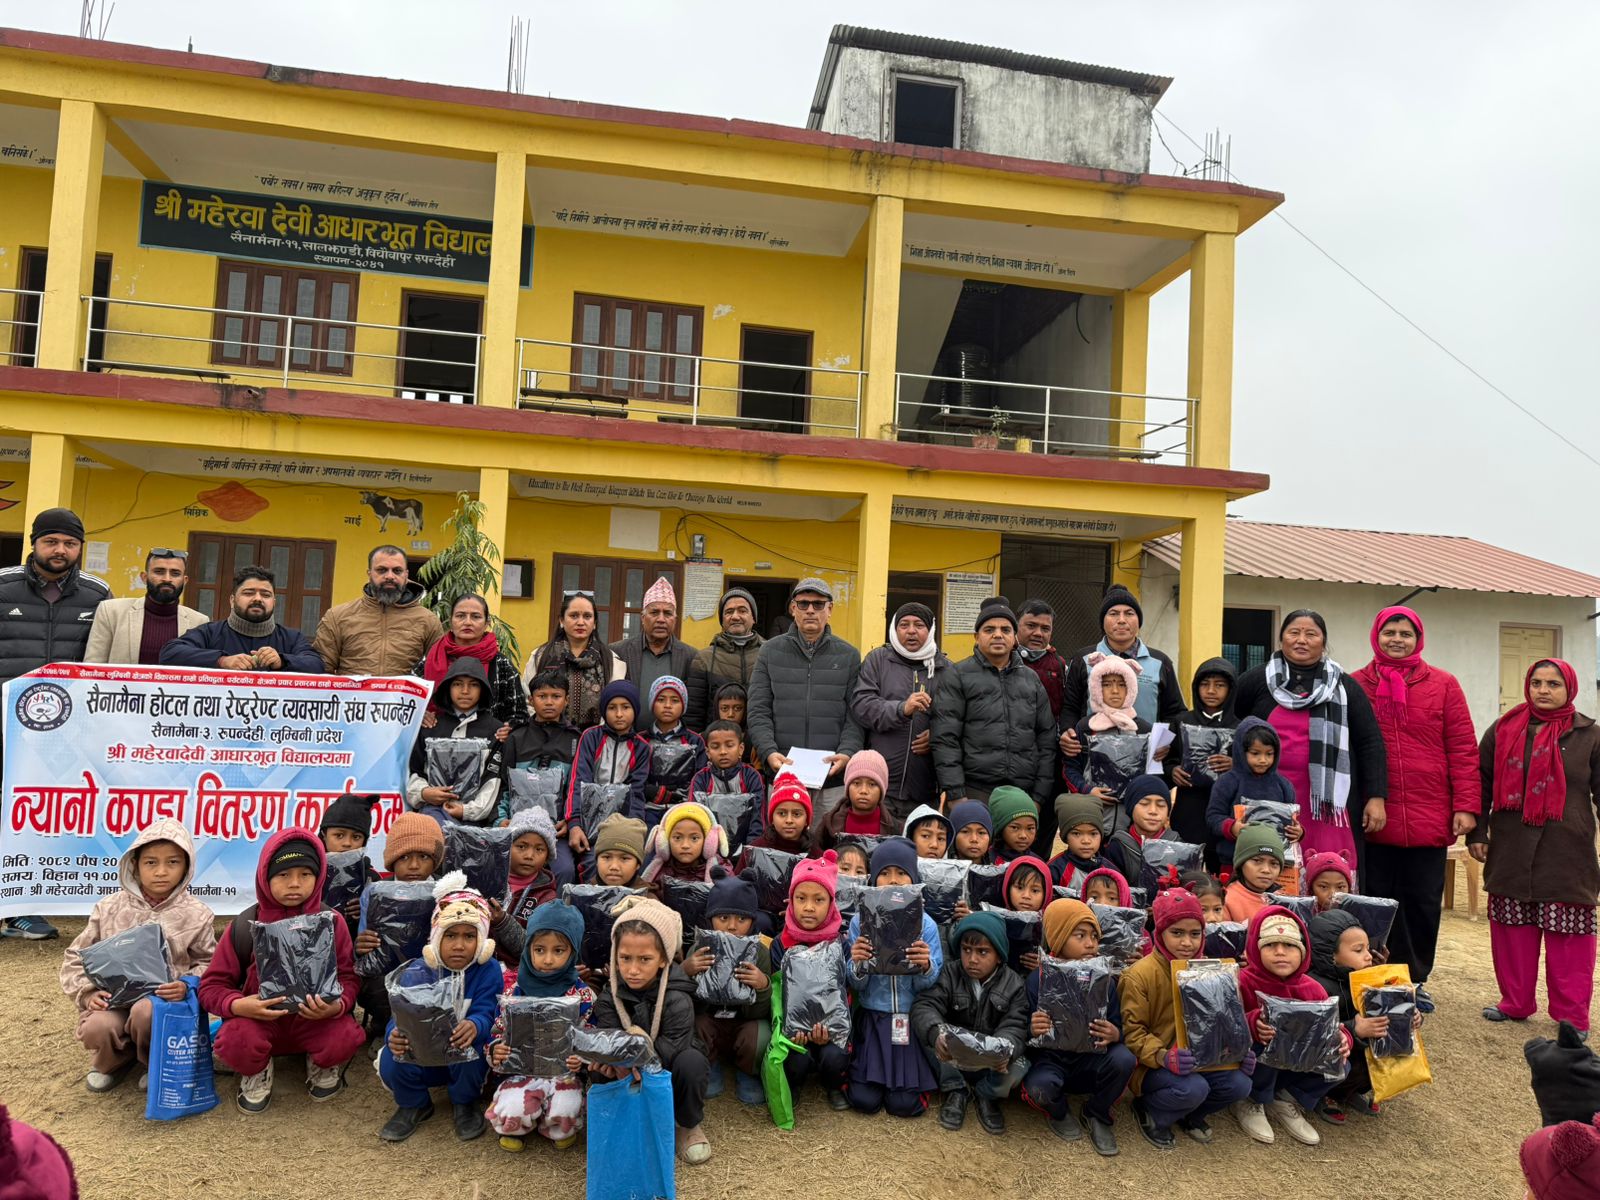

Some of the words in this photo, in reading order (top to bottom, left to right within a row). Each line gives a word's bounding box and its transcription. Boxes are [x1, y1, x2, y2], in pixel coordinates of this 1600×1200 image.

[154, 188, 182, 221] श्री
[187, 194, 267, 232] महेरवा
[271, 202, 313, 237] देवी
[314, 213, 418, 251] आधारभूत
[423, 219, 491, 256] विद्याल
[86, 682, 146, 714] सैनामैना
[149, 688, 190, 717] होटल
[193, 695, 222, 718] तथा
[282, 694, 340, 722] व्यवसायी
[344, 697, 367, 723] संघ
[270, 726, 312, 743] लुम्बिनी
[316, 727, 342, 743] प्रदेश
[107, 744, 127, 764] श्री
[131, 745, 206, 764] महेरवादेवी
[209, 748, 277, 766] आधारभूत
[281, 747, 352, 765] विद्यालयमा
[12, 770, 100, 835] न्यानो
[194, 772, 289, 839] वितरण
[38, 856, 71, 867] २०८२
[76, 854, 98, 867] पौष
[102, 857, 118, 867] २०
[42, 868, 80, 881] विहान
[30, 883, 43, 896] श्री
[45, 883, 94, 896] महेरवादेवी
